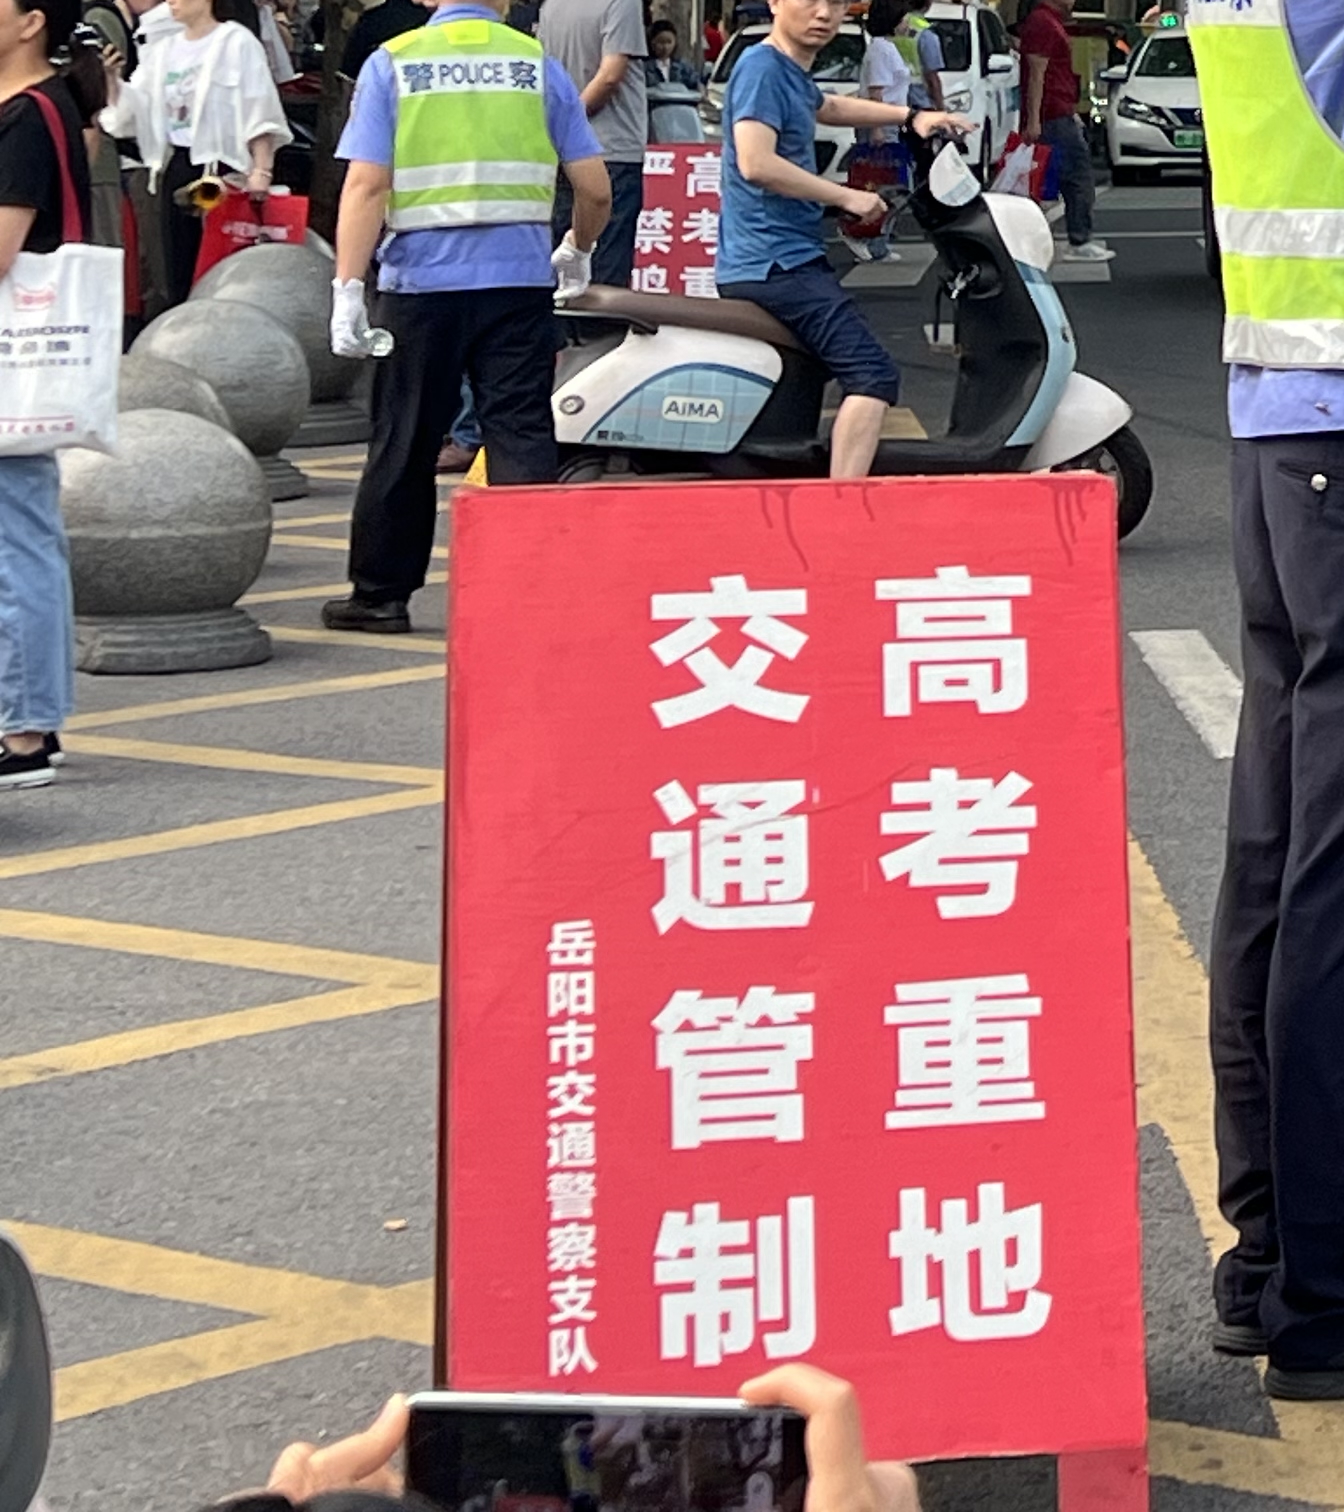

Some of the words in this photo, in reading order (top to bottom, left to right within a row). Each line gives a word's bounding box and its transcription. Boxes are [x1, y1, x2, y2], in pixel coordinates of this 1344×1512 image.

[438, 63, 504, 85] POLICE
[509, 61, 537, 89] 察
[664, 400, 719, 419] AIMA
[546, 918, 598, 1377] 岳阳市交通警察支队
[650, 574, 818, 1368] 交通管制
[874, 565, 1053, 1342] 高考重地
